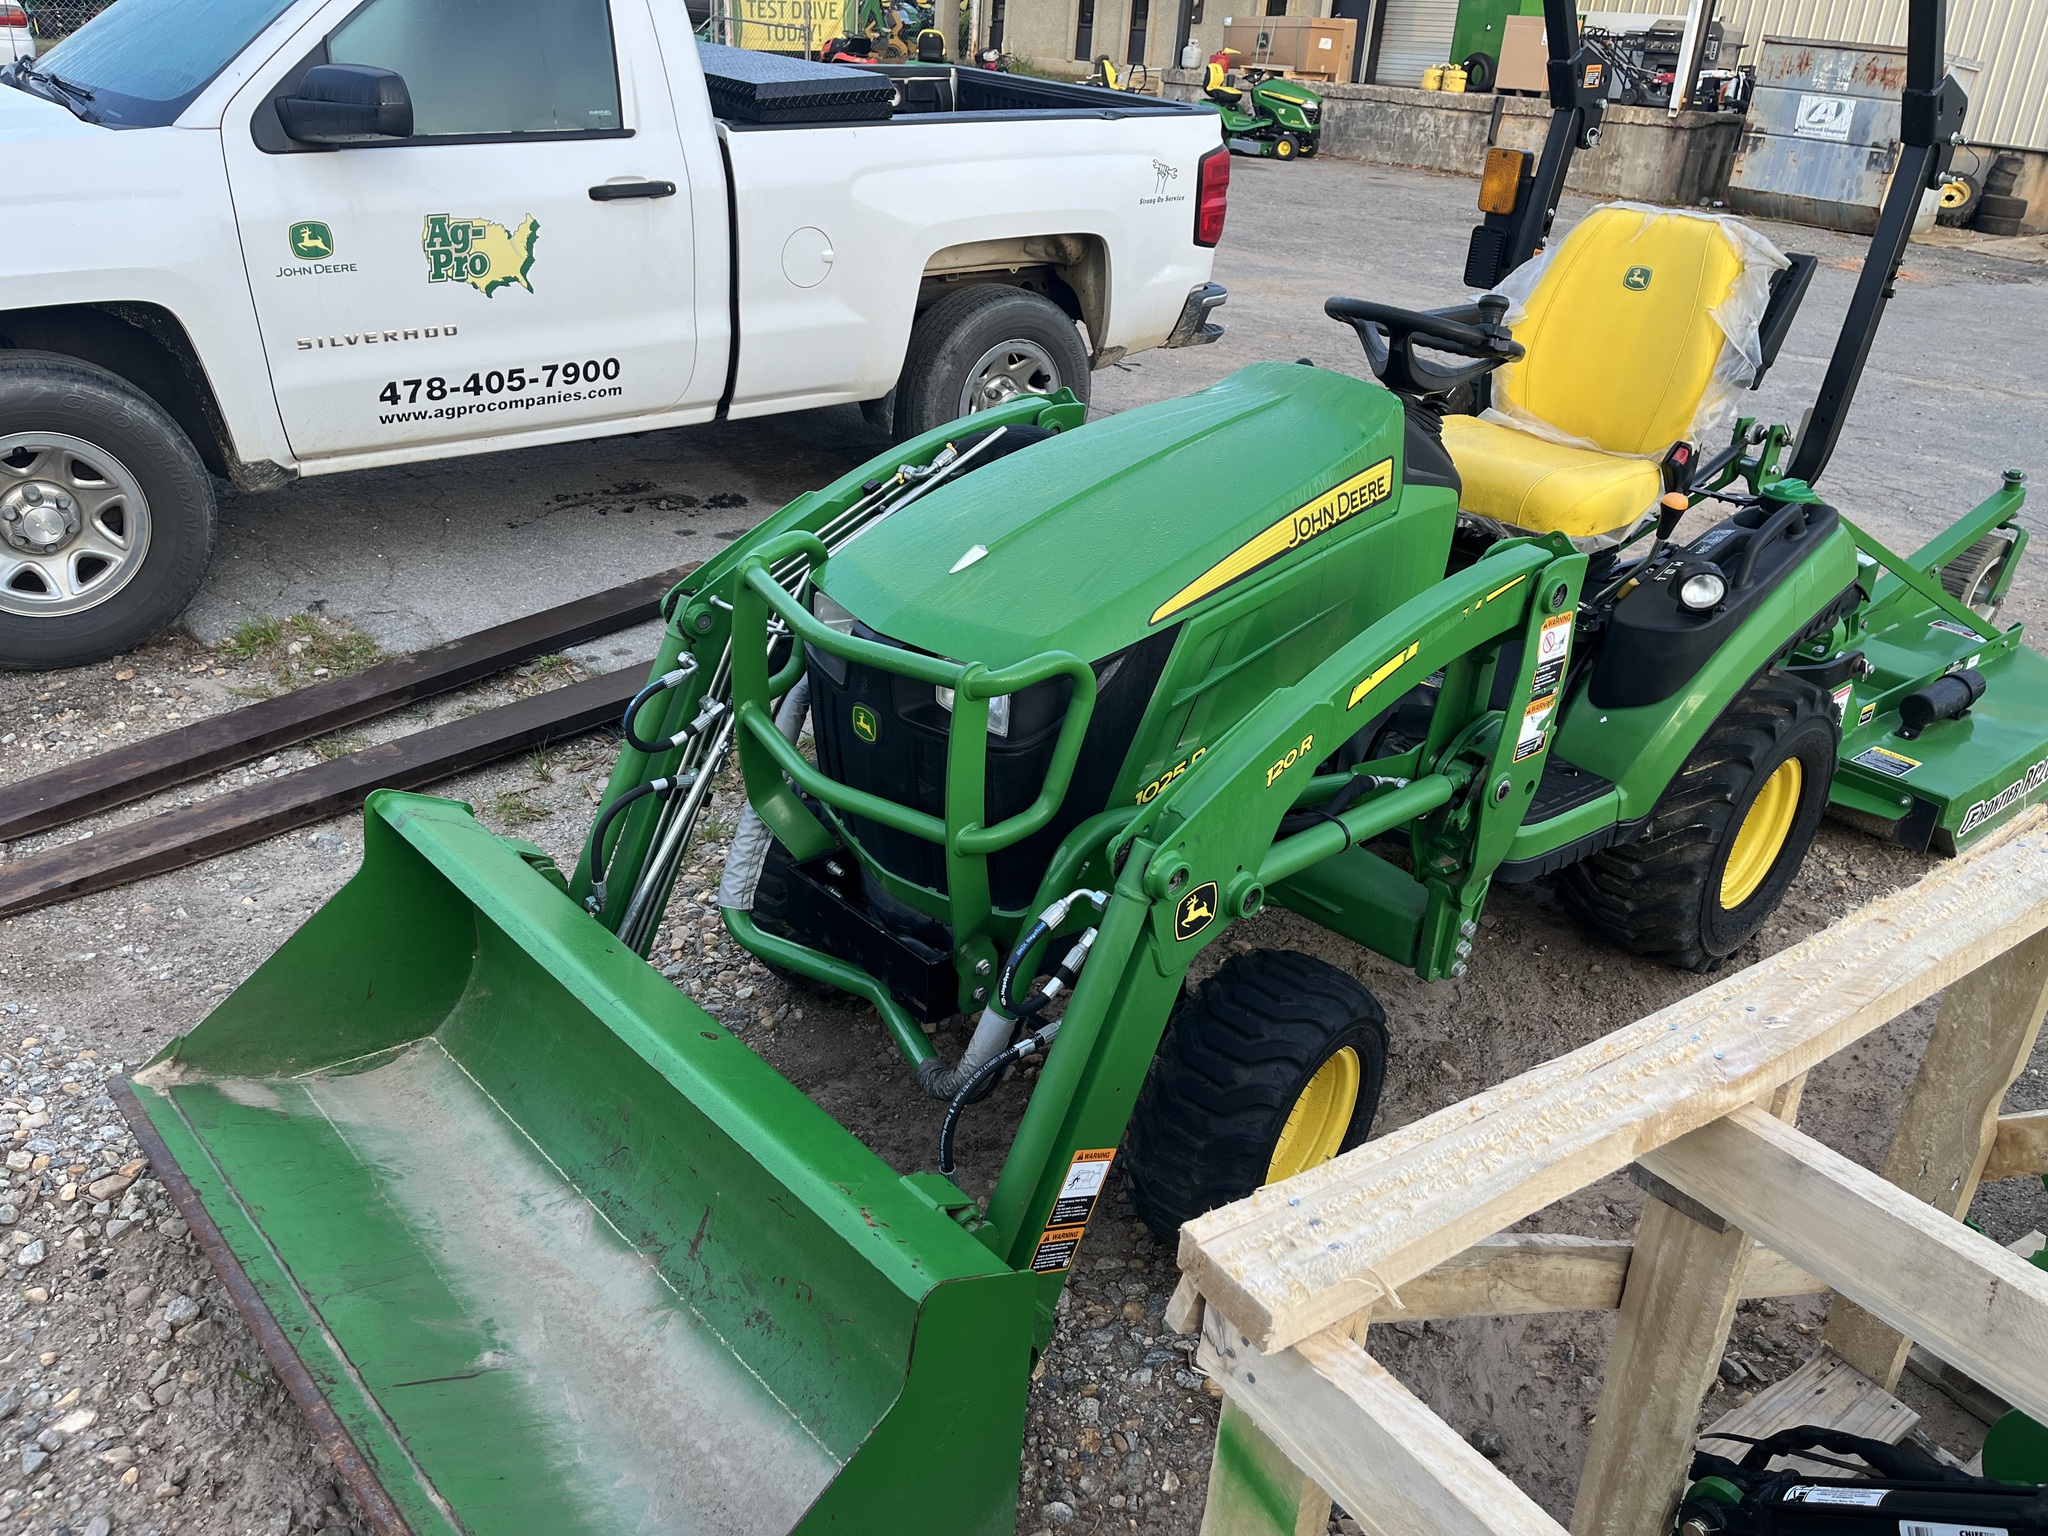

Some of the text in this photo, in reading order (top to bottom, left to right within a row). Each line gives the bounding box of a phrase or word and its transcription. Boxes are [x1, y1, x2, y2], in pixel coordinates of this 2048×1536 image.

[747, 0, 787, 19] TEST
[1165, 194, 1185, 202] Service
[426, 213, 486, 253] Ag-
[275, 262, 358, 278] JOHN DEERE
[428, 248, 490, 283] Pro
[297, 324, 459, 350] SILVERADO
[378, 357, 621, 406] 478-405-7900
[378, 385, 623, 426] www.agprocompanies.com
[1289, 475, 1386, 545] JOHN DEERE
[1266, 734, 1314, 789] 120 R
[1960, 781, 2021, 834] FRONTIER
[1084, 1152, 1110, 1160] WARNING
[1052, 1231, 1079, 1240] WARNING
